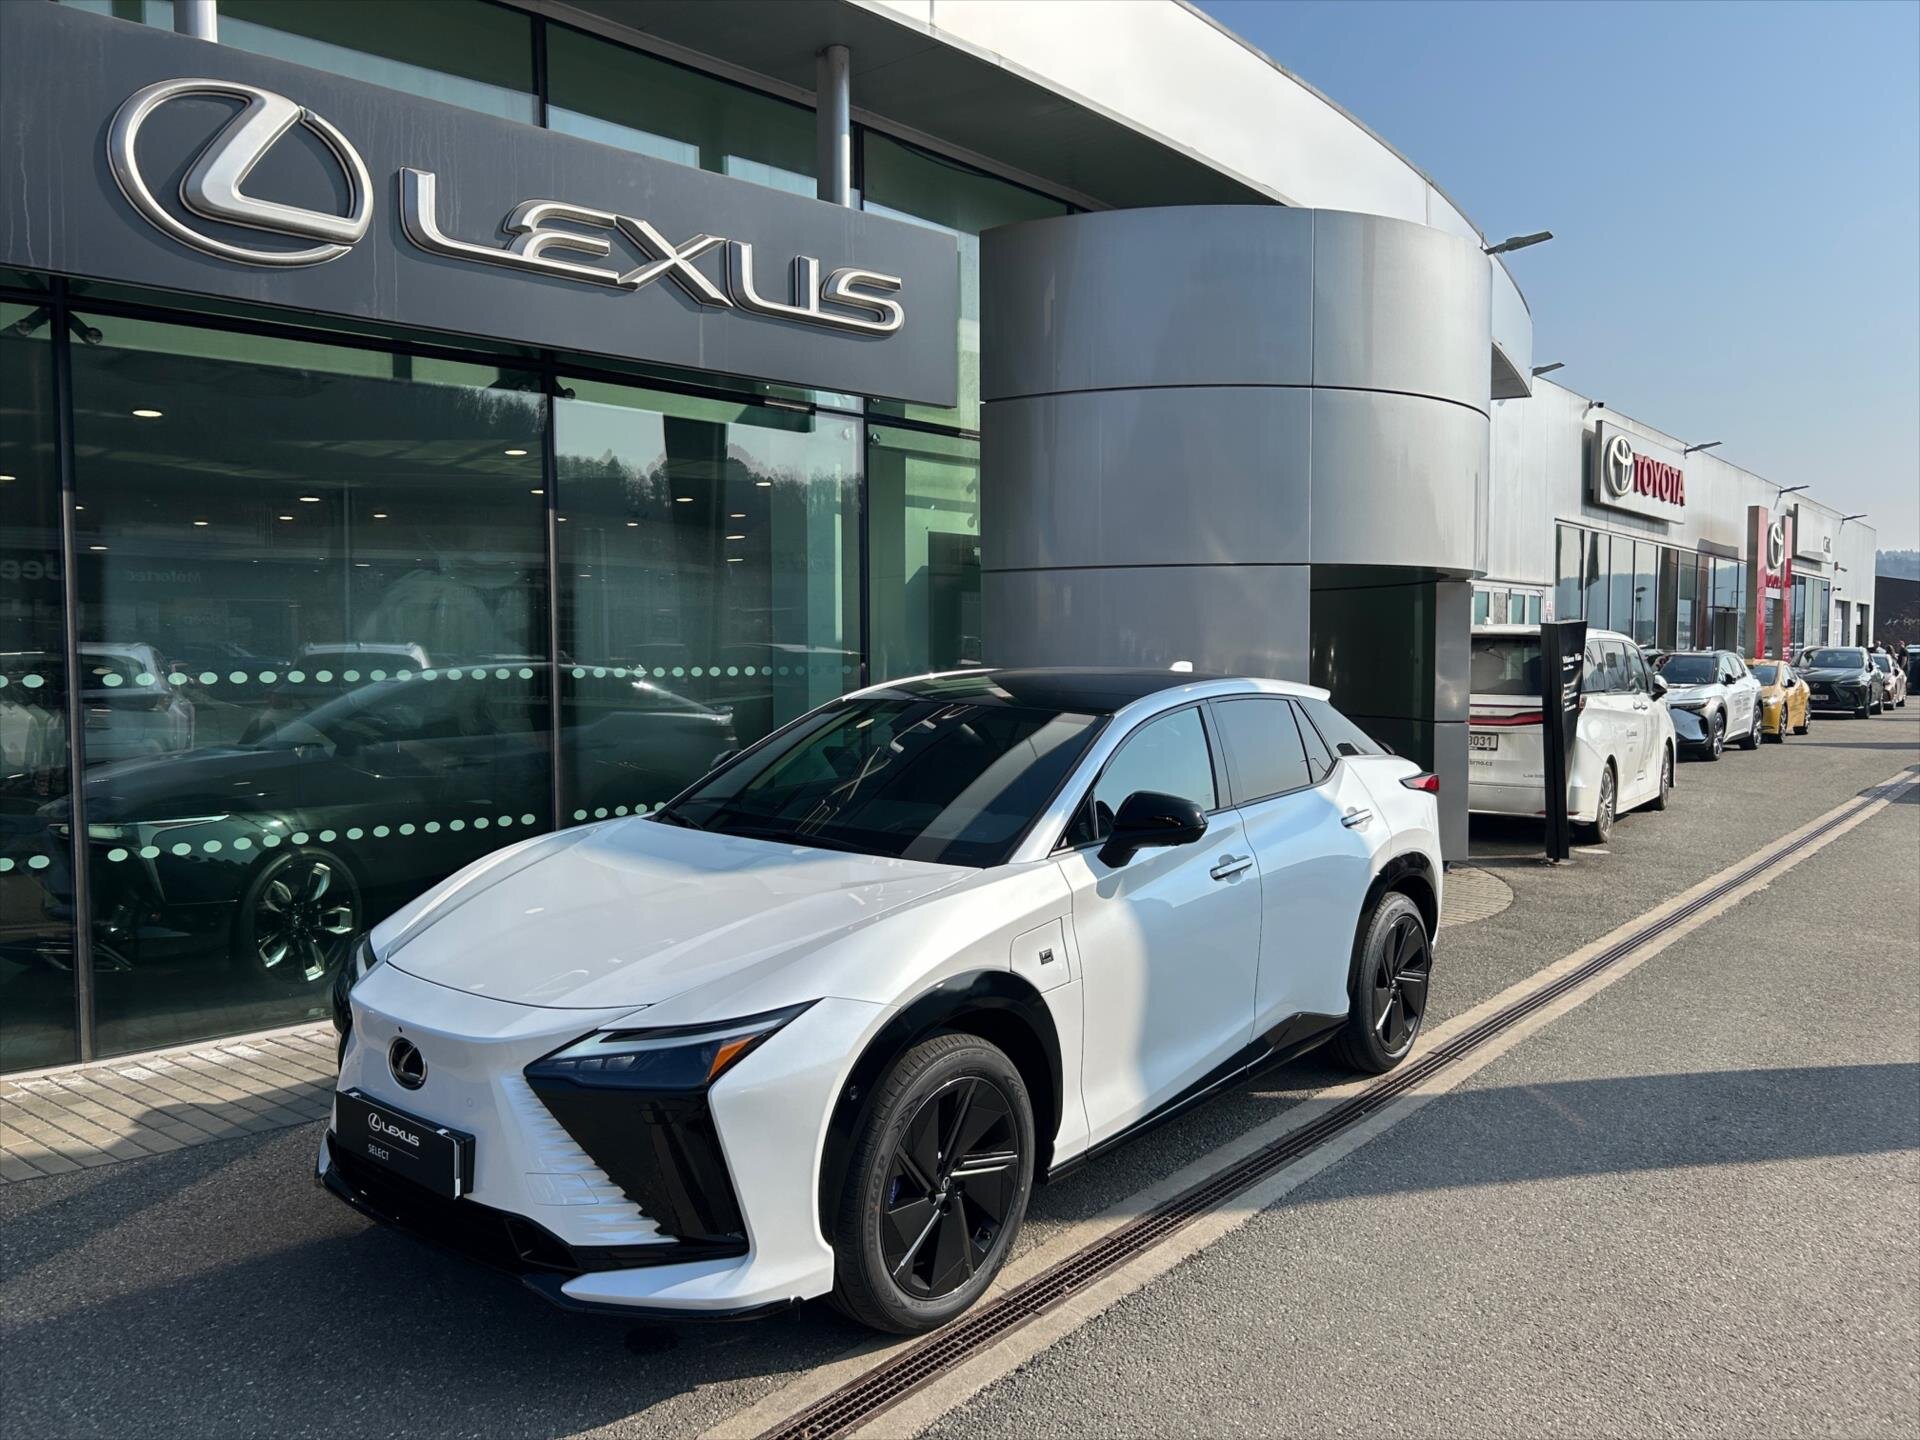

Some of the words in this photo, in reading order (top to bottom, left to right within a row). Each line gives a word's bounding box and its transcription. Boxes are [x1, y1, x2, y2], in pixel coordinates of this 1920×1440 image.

[399, 166, 905, 338] LEXUS
[1632, 452, 1686, 507] TOYOTA
[368, 1143, 390, 1161] SELECT
[381, 1123, 420, 1147] LEXUS
